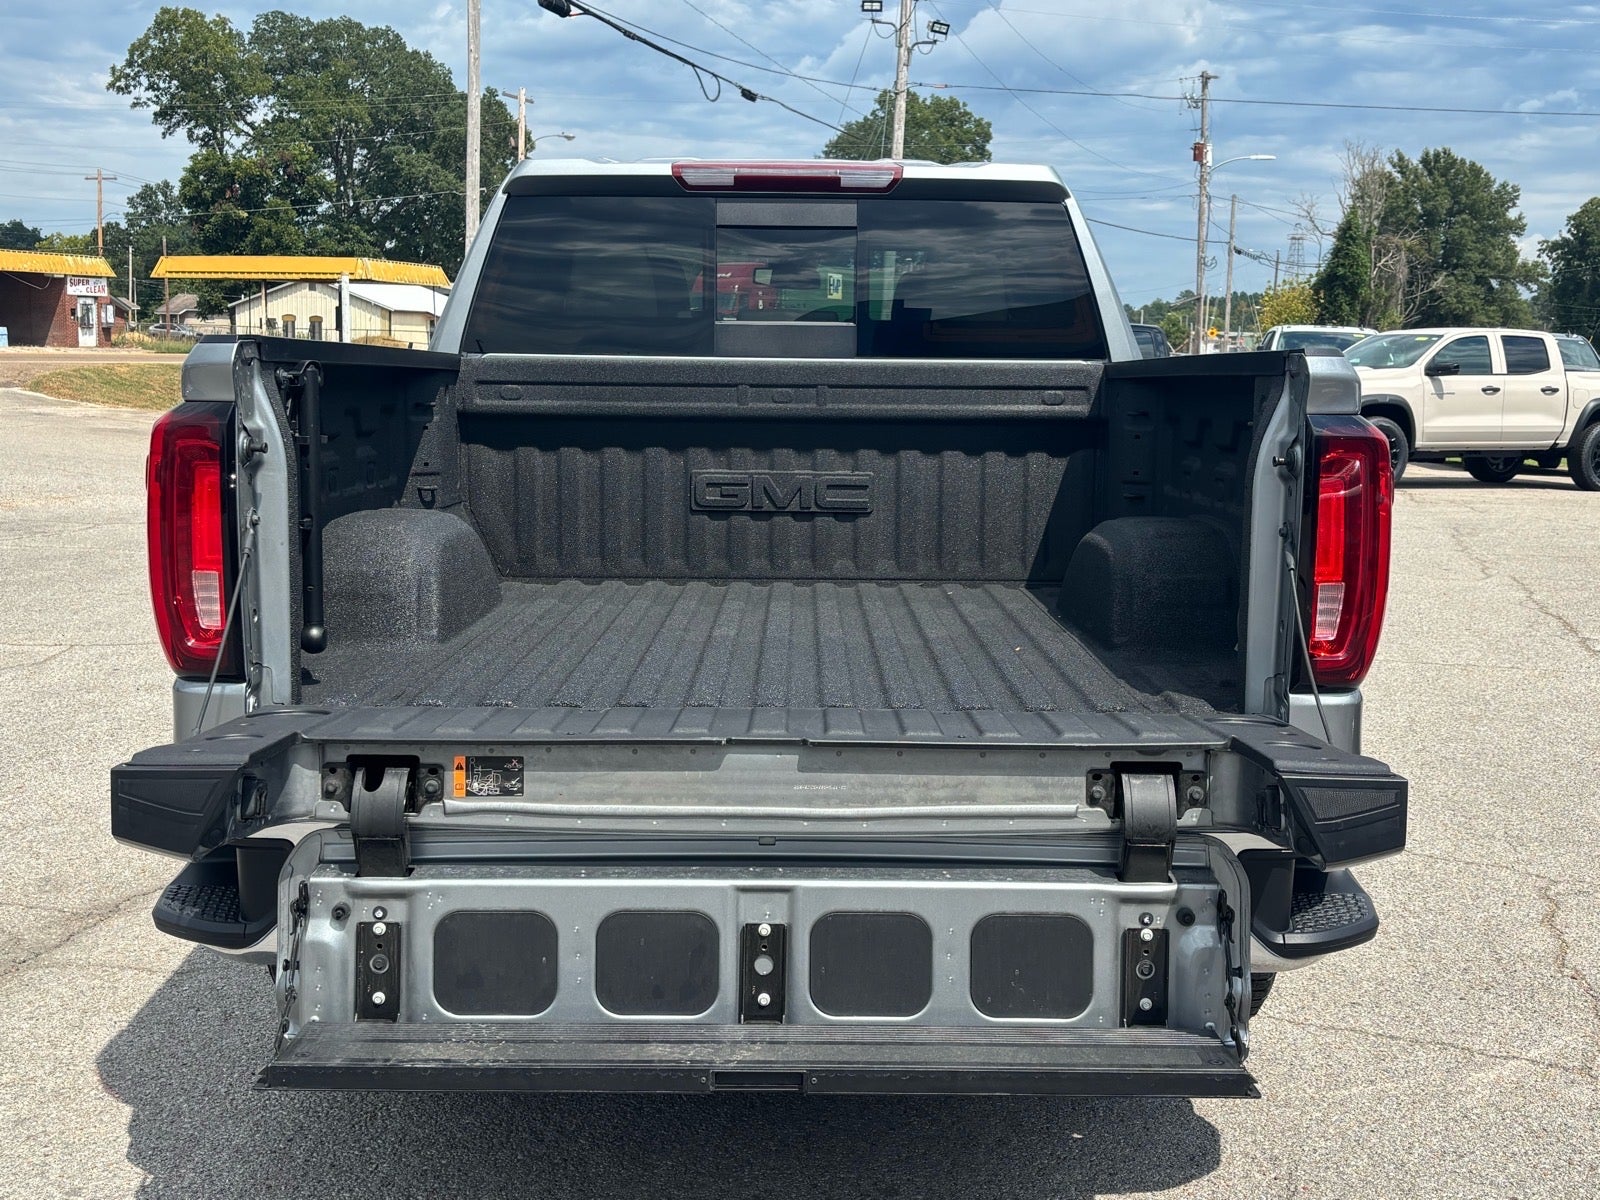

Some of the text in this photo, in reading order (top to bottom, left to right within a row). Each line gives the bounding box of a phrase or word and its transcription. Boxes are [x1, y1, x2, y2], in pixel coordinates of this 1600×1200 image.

[69, 278, 90, 287] SUPER
[85, 285, 106, 294] CLEAN
[694, 474, 870, 511] GMC
